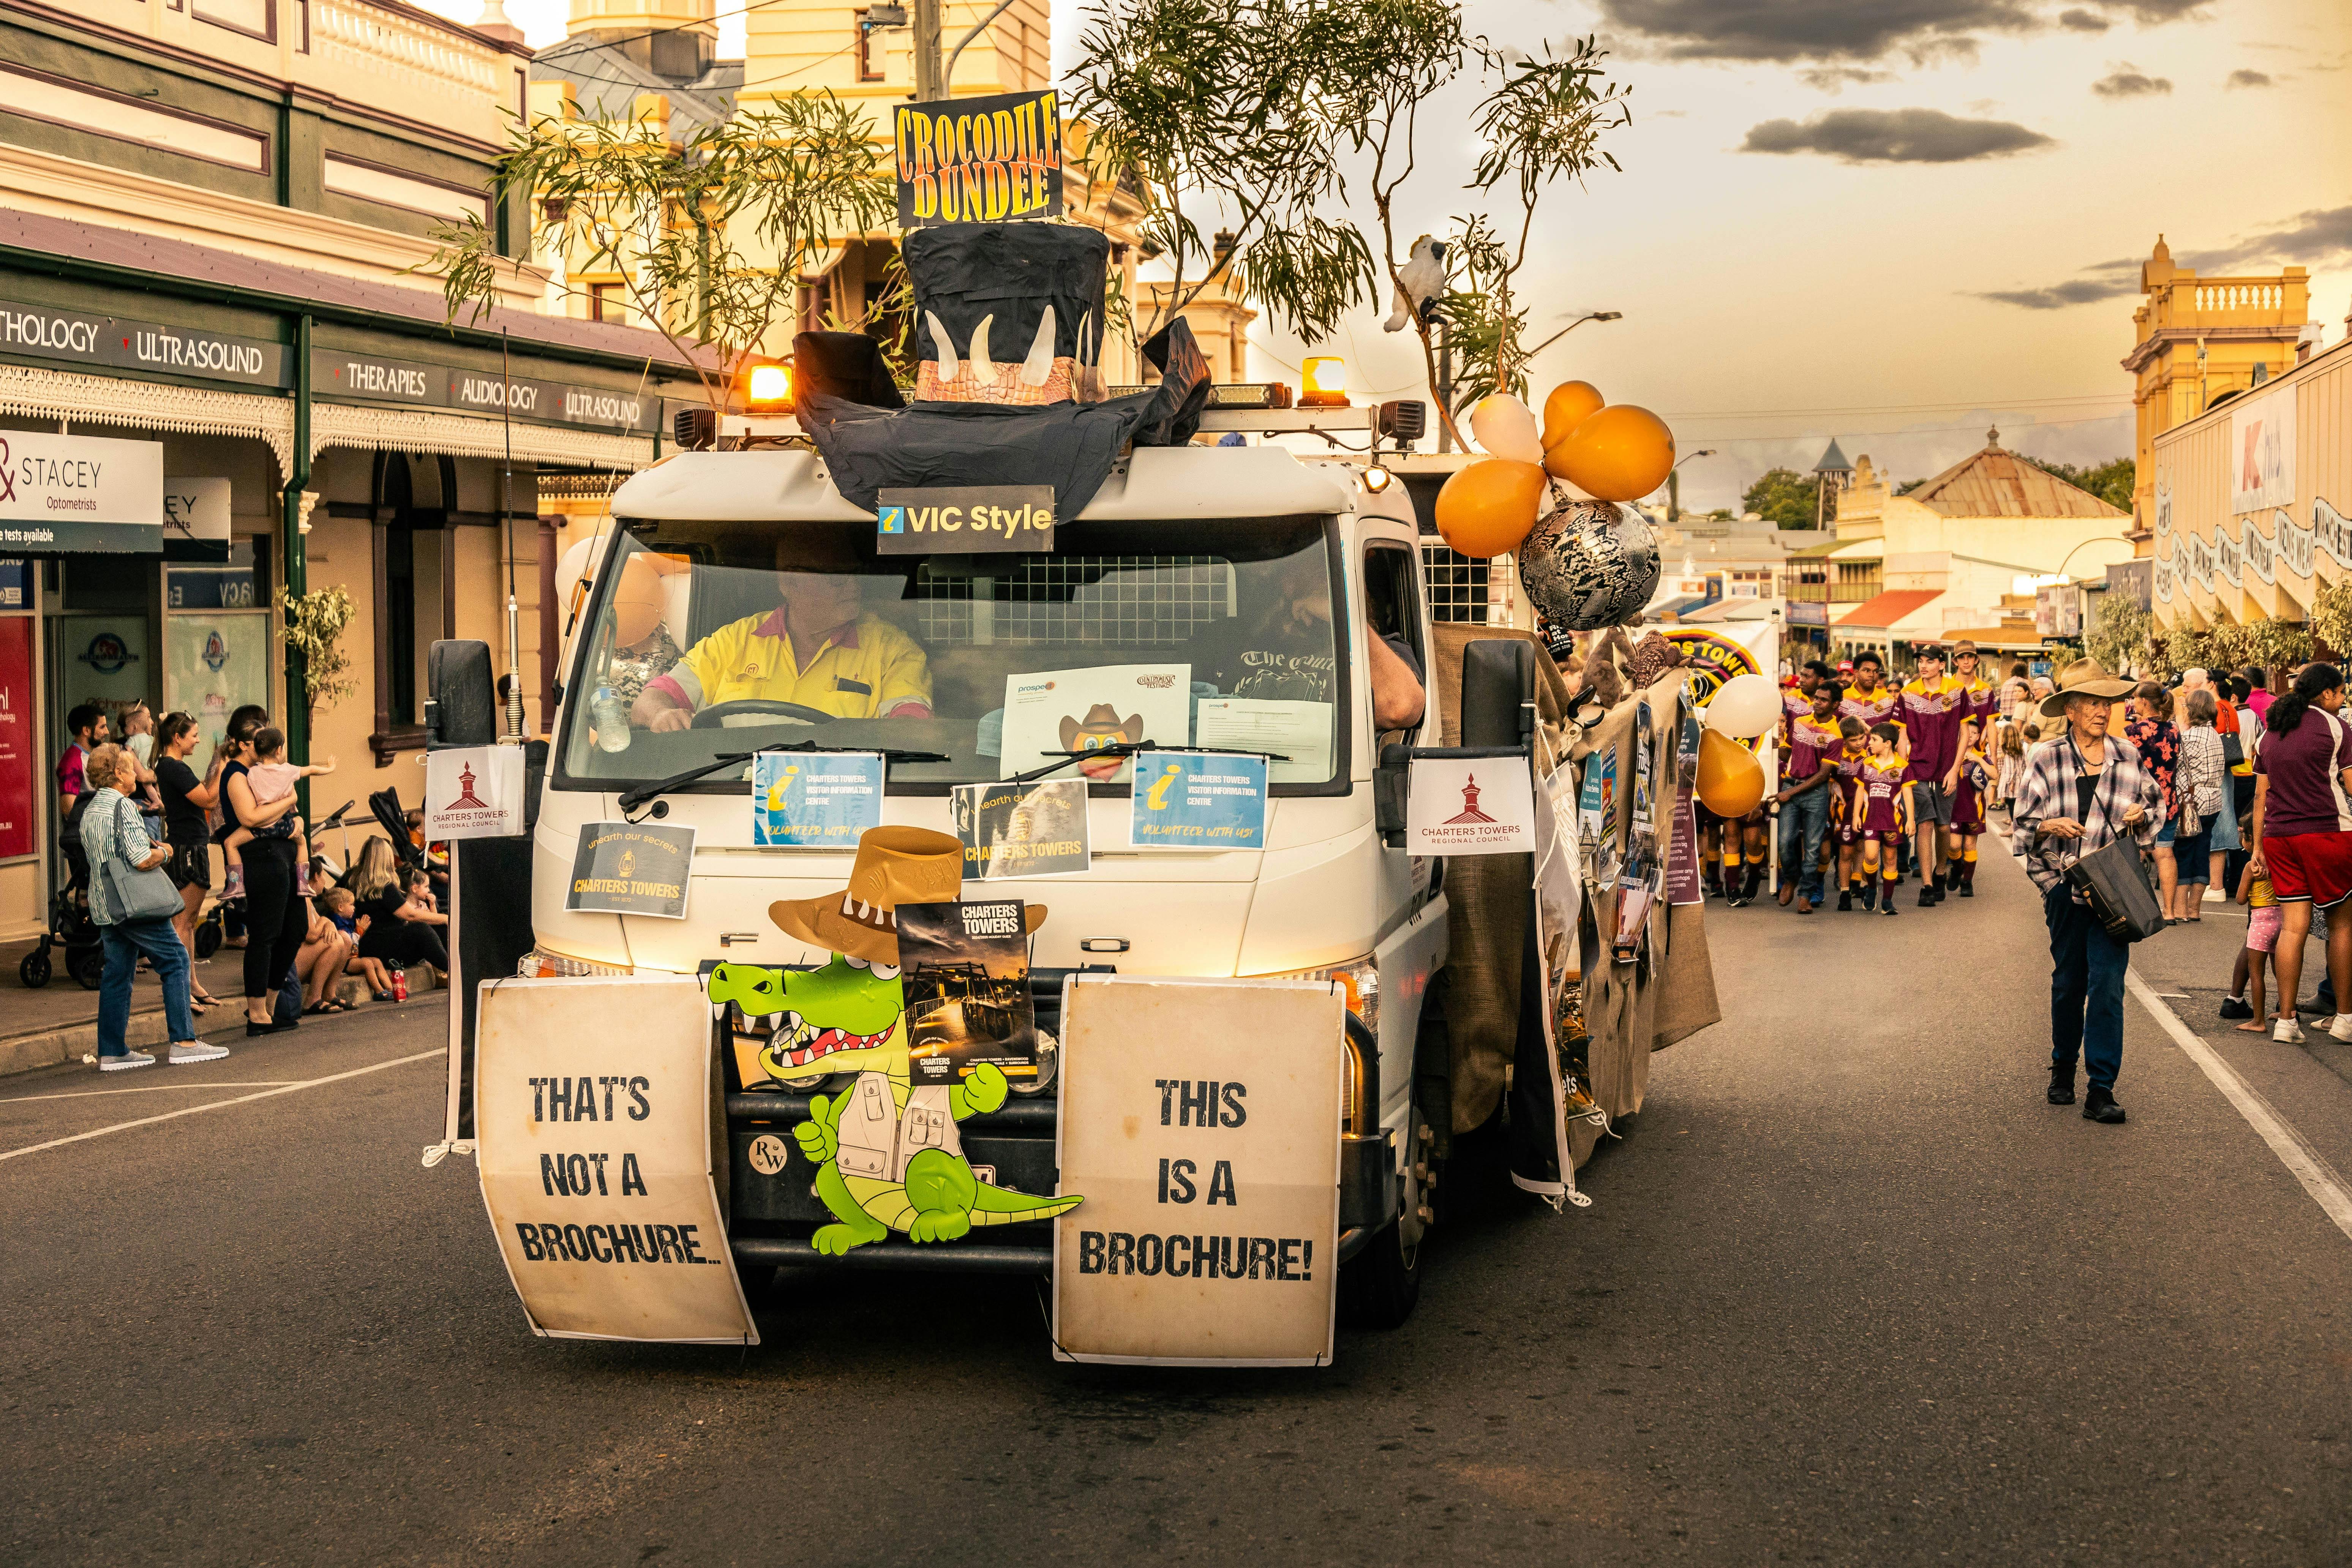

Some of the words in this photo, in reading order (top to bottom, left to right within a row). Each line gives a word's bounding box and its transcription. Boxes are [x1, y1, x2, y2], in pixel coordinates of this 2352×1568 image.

[897, 92, 1059, 183] CROCODILE
[913, 161, 1049, 222] DUNDEE
[137, 332, 262, 374] ULTRASOUND
[348, 362, 425, 396] THERAPIES
[566, 392, 640, 422] ULTRASOUND
[2242, 419, 2263, 491] K
[22, 457, 101, 489] STACEY
[47, 496, 97, 512] Optometrists
[907, 506, 963, 532] VIC
[970, 504, 1052, 538] Style
[5, 529, 22, 541] tests
[24, 528, 54, 542] available
[2297, 535, 2314, 570] WEAR
[1241, 651, 1286, 666] The
[1188, 775, 1221, 783] CHARTERS
[1223, 775, 1250, 784] TOWERS
[1187, 797, 1212, 806] CENTRE
[1188, 786, 1212, 794] VISITOR
[1213, 787, 1257, 796] INFORMATION
[433, 813, 471, 822] CHARTERS
[474, 810, 509, 819] TOWERS
[764, 825, 822, 836] VOLUNTEER
[825, 826, 850, 836] WITH
[1143, 824, 1204, 836] VOLUNTEER
[1207, 827, 1234, 838] WITH
[1422, 827, 1475, 836] CHARTERS
[1478, 825, 1520, 835] TOWERS
[588, 832, 622, 850] unearth
[644, 835, 678, 854] secrets
[965, 845, 1028, 862] CHARTERS
[1030, 840, 1082, 857] TOWERS
[574, 879, 628, 894] CHARTERS
[630, 881, 680, 898] TOWERS
[962, 904, 1017, 919] CHARTERS
[963, 918, 1019, 934] TOWERS
[920, 1057, 950, 1066] CHARTERS
[529, 1076, 650, 1122] THAT'S
[1155, 1079, 1247, 1128] THIS
[540, 1153, 609, 1197] NOT
[622, 1153, 648, 1197] A
[1158, 1157, 1197, 1205] IS
[1207, 1160, 1237, 1206] A
[515, 1222, 722, 1265] BROCHURE...
[1079, 1230, 1313, 1281] BROCHURE!
